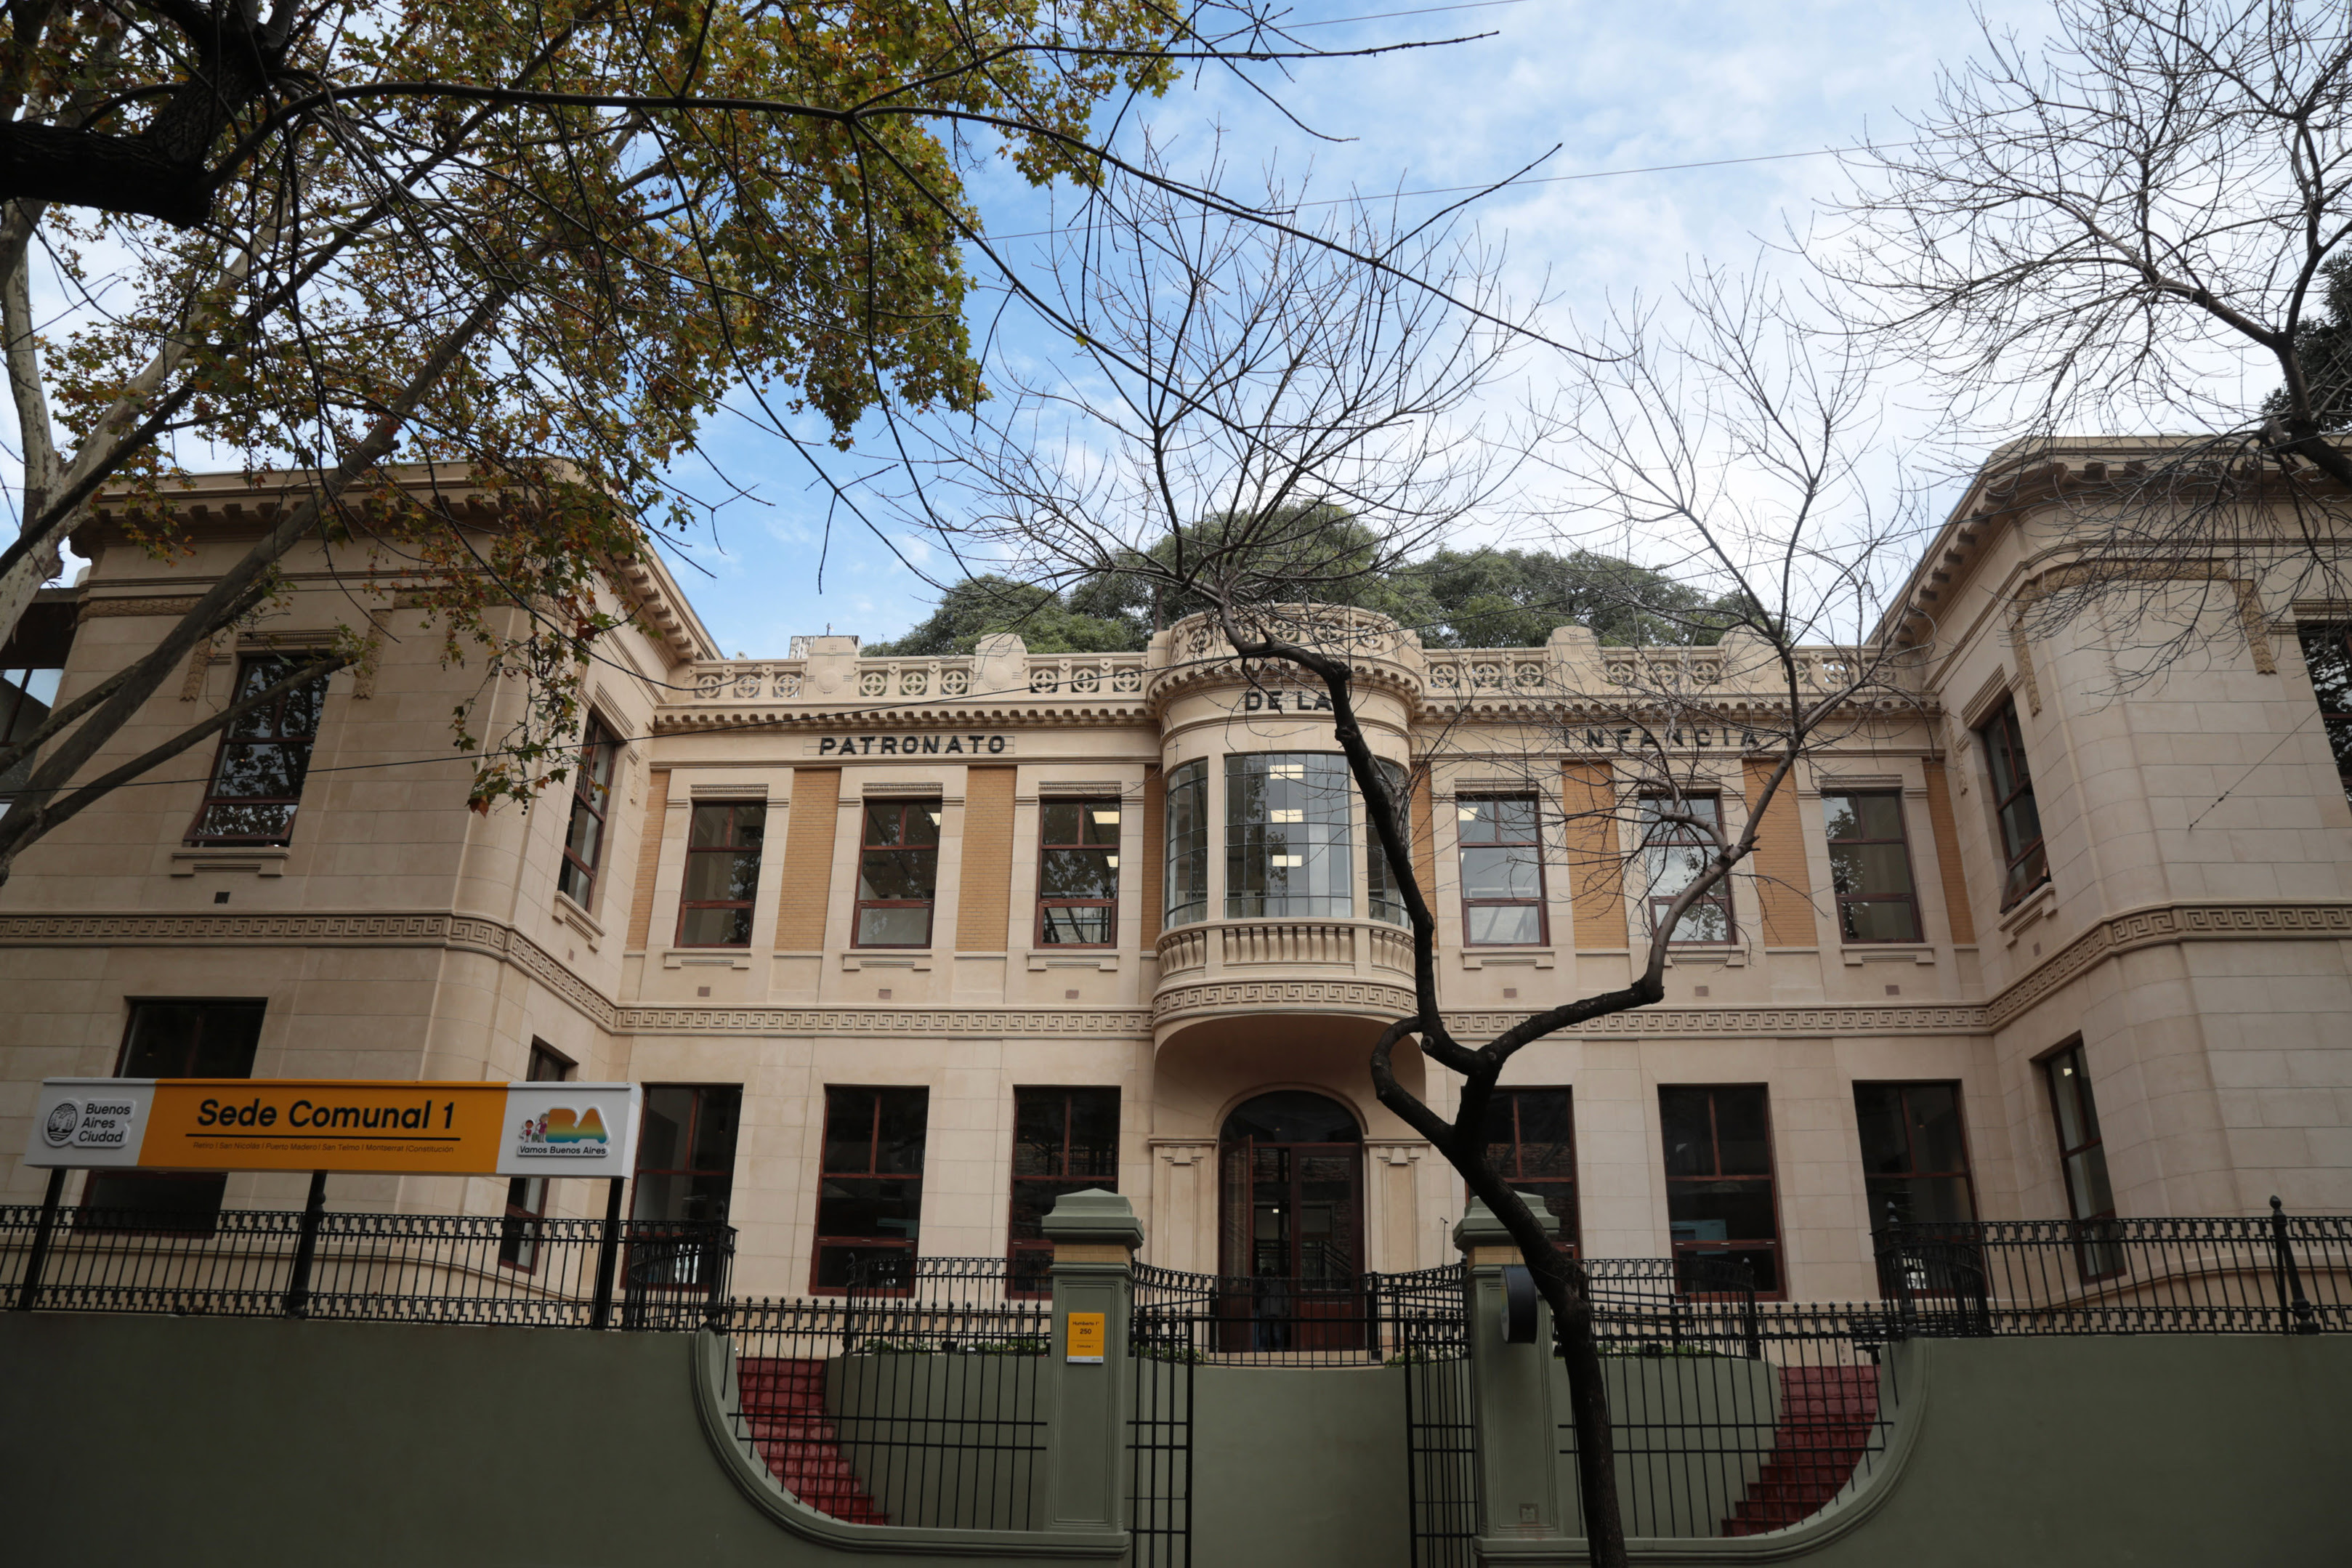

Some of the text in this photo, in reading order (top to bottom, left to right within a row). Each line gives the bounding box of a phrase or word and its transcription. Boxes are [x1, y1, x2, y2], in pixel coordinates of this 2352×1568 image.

[819, 690, 1760, 756] PATRONATO DE LA INFANCIA
[85, 1103, 131, 1115] Buenos
[197, 1098, 454, 1129] Sede Comunal 1
[81, 1117, 116, 1128] Aires
[78, 1131, 124, 1142] Ciudad
